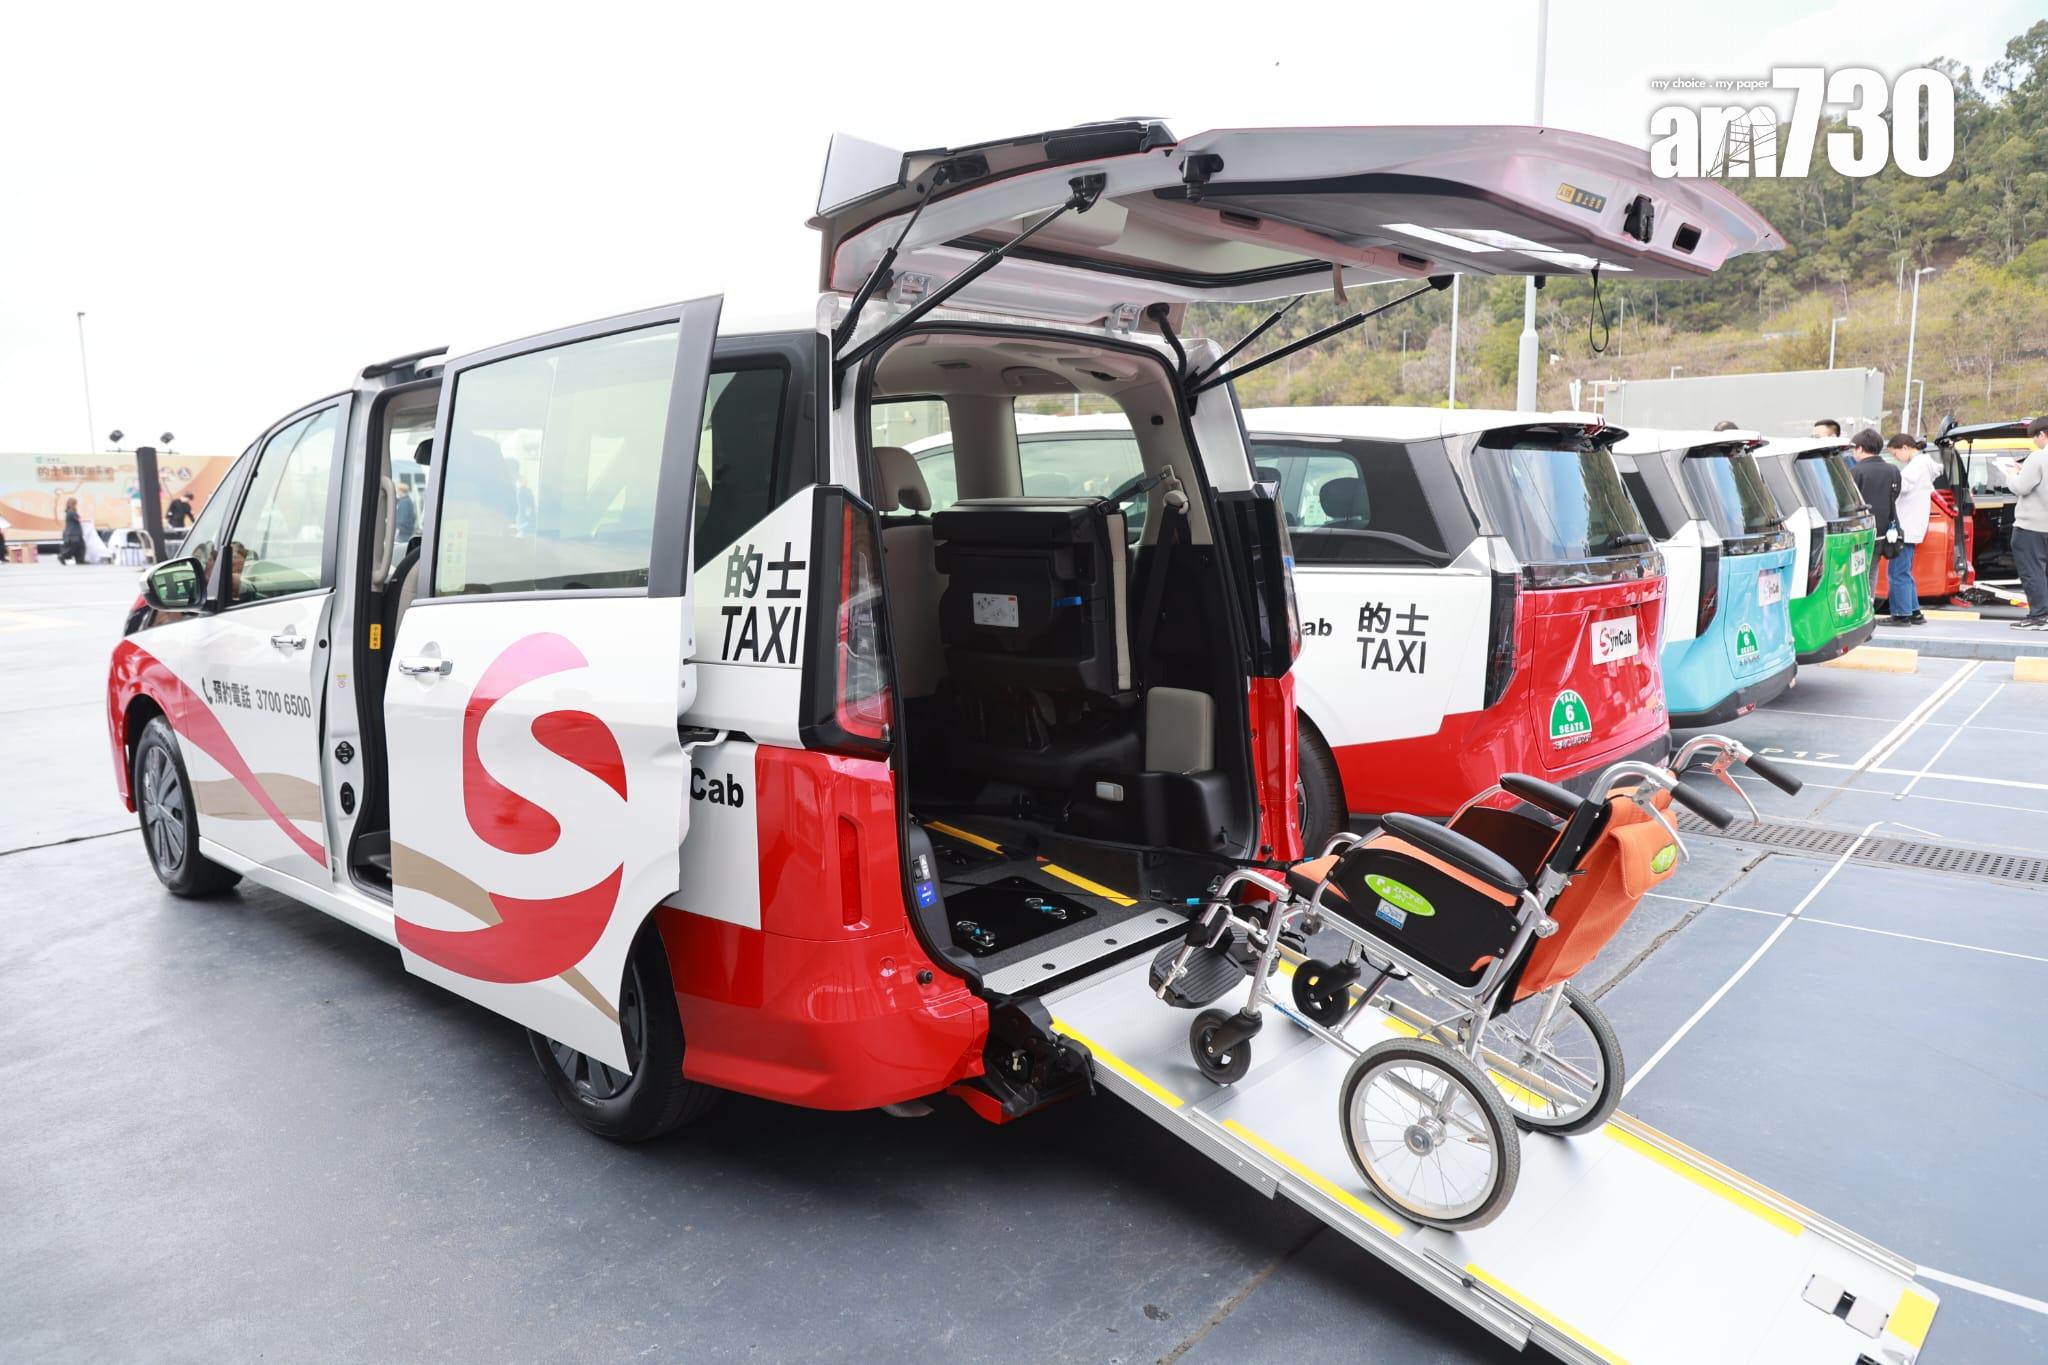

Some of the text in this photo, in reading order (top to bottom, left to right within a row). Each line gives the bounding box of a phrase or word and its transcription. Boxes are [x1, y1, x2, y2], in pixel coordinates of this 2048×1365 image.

[724, 542, 806, 599] 的士
[721, 606, 802, 664] TAXI
[1301, 617, 1333, 637] ab
[1358, 601, 1429, 637] 的士
[1356, 636, 1427, 674] TAXI
[255, 689, 282, 713] 3700
[283, 693, 312, 718] 6500
[1565, 704, 1575, 722] 6
[1558, 721, 1585, 734] SEATS
[690, 767, 745, 809] Cab
